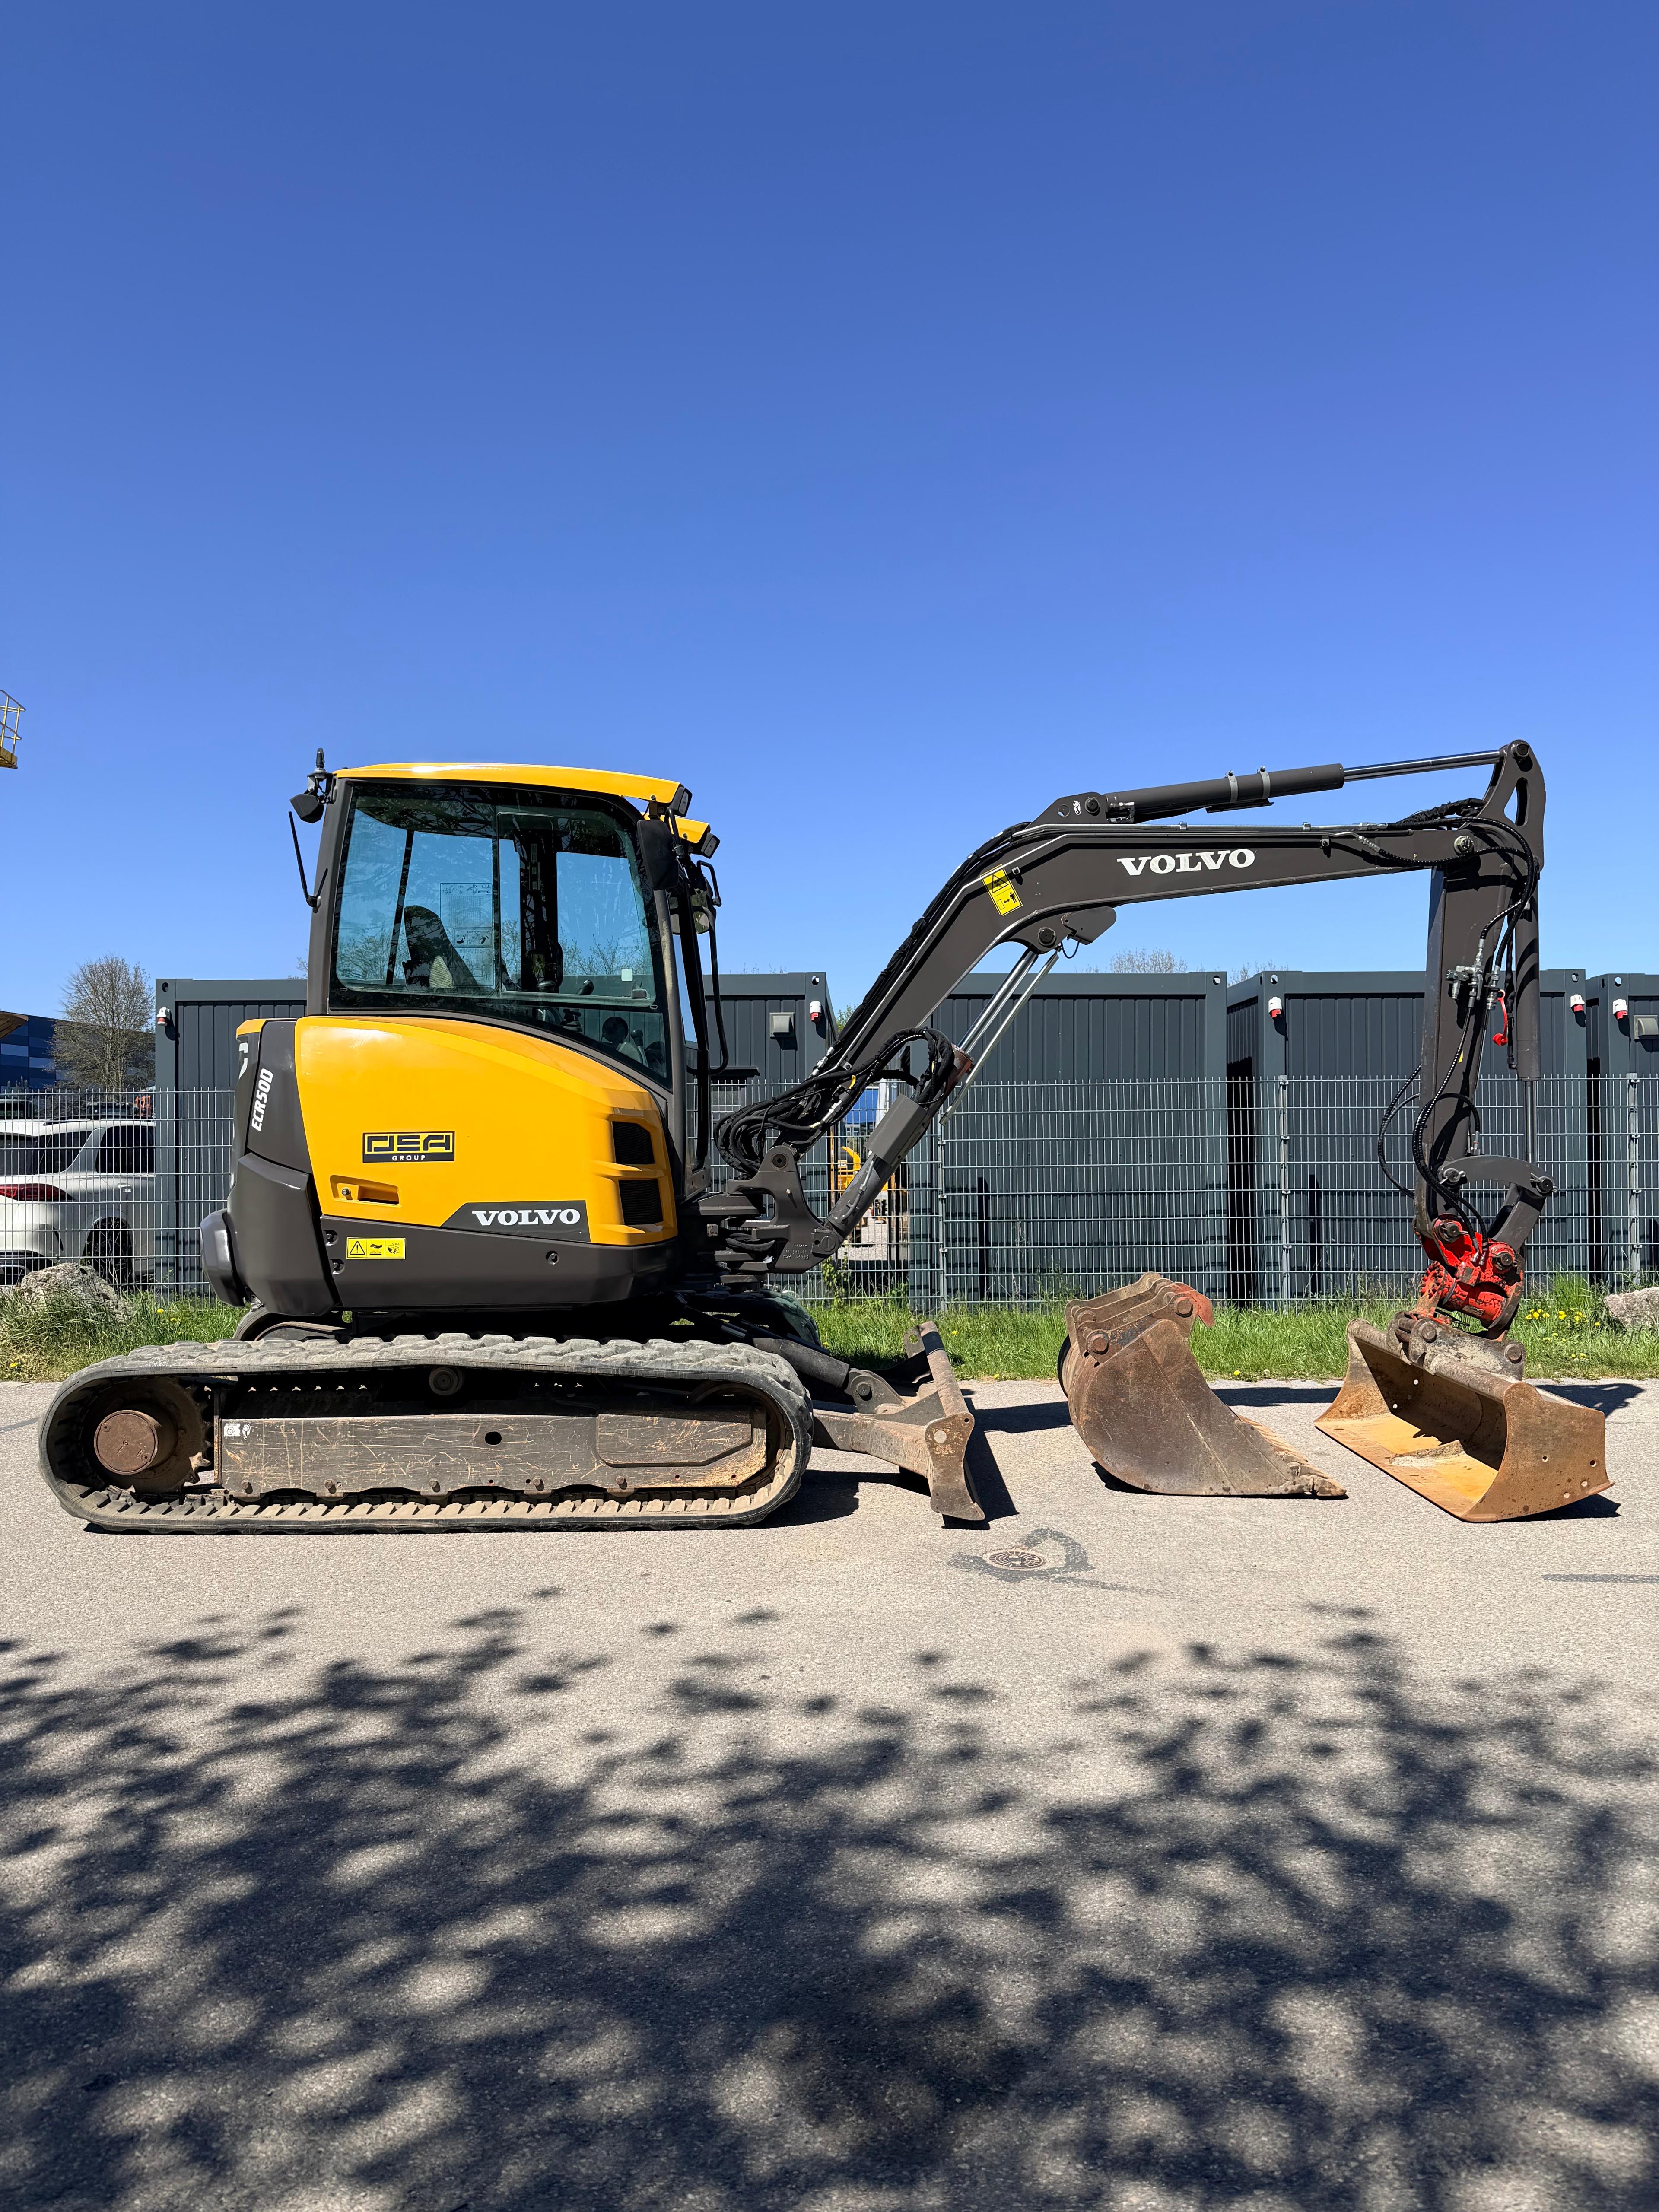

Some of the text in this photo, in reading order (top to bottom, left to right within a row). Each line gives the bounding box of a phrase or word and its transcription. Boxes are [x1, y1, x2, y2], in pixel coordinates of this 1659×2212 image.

[1117, 849, 1255, 876] VOLVO
[251, 1068, 273, 1132] ECR50D
[472, 1209, 580, 1226] VOLVO
